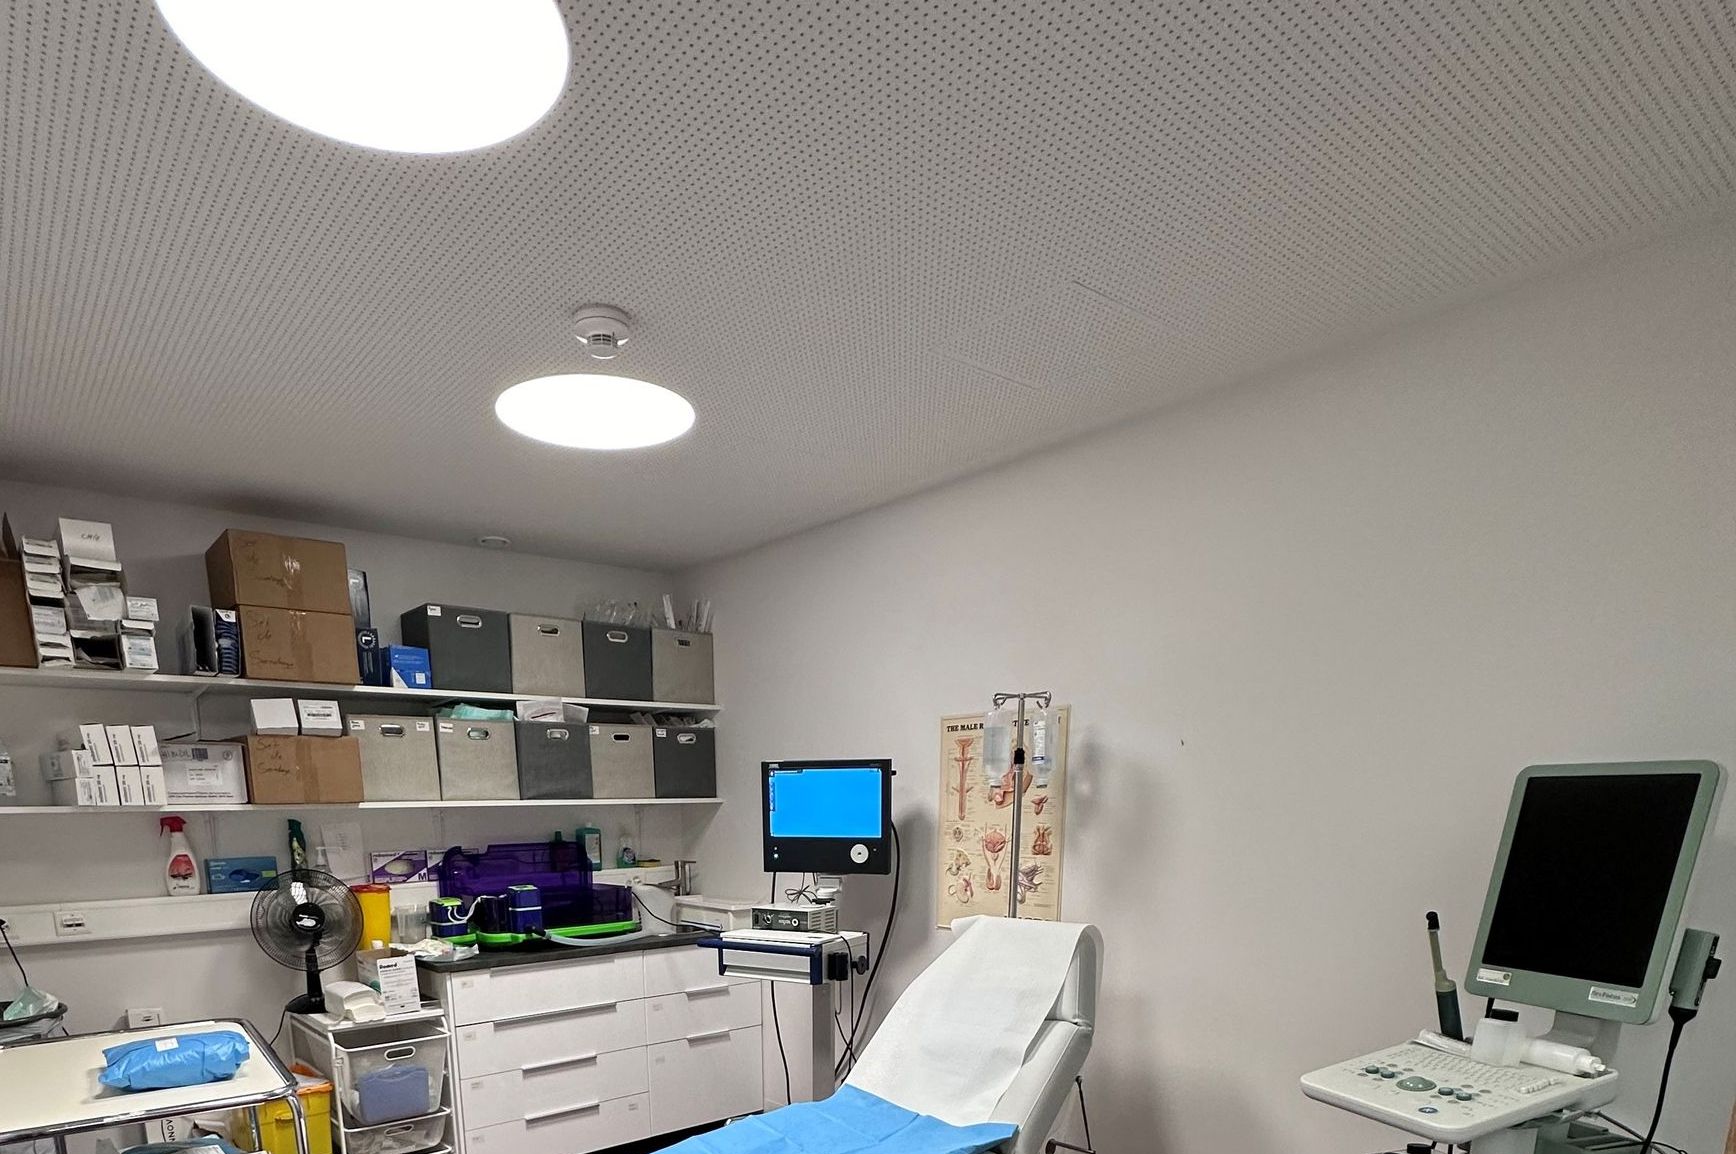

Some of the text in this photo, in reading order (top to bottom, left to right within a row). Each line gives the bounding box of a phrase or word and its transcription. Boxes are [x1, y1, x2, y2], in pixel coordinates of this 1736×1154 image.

[946, 724, 960, 733] THE
[960, 722, 978, 732] MALE
[418, 872, 427, 881] M
